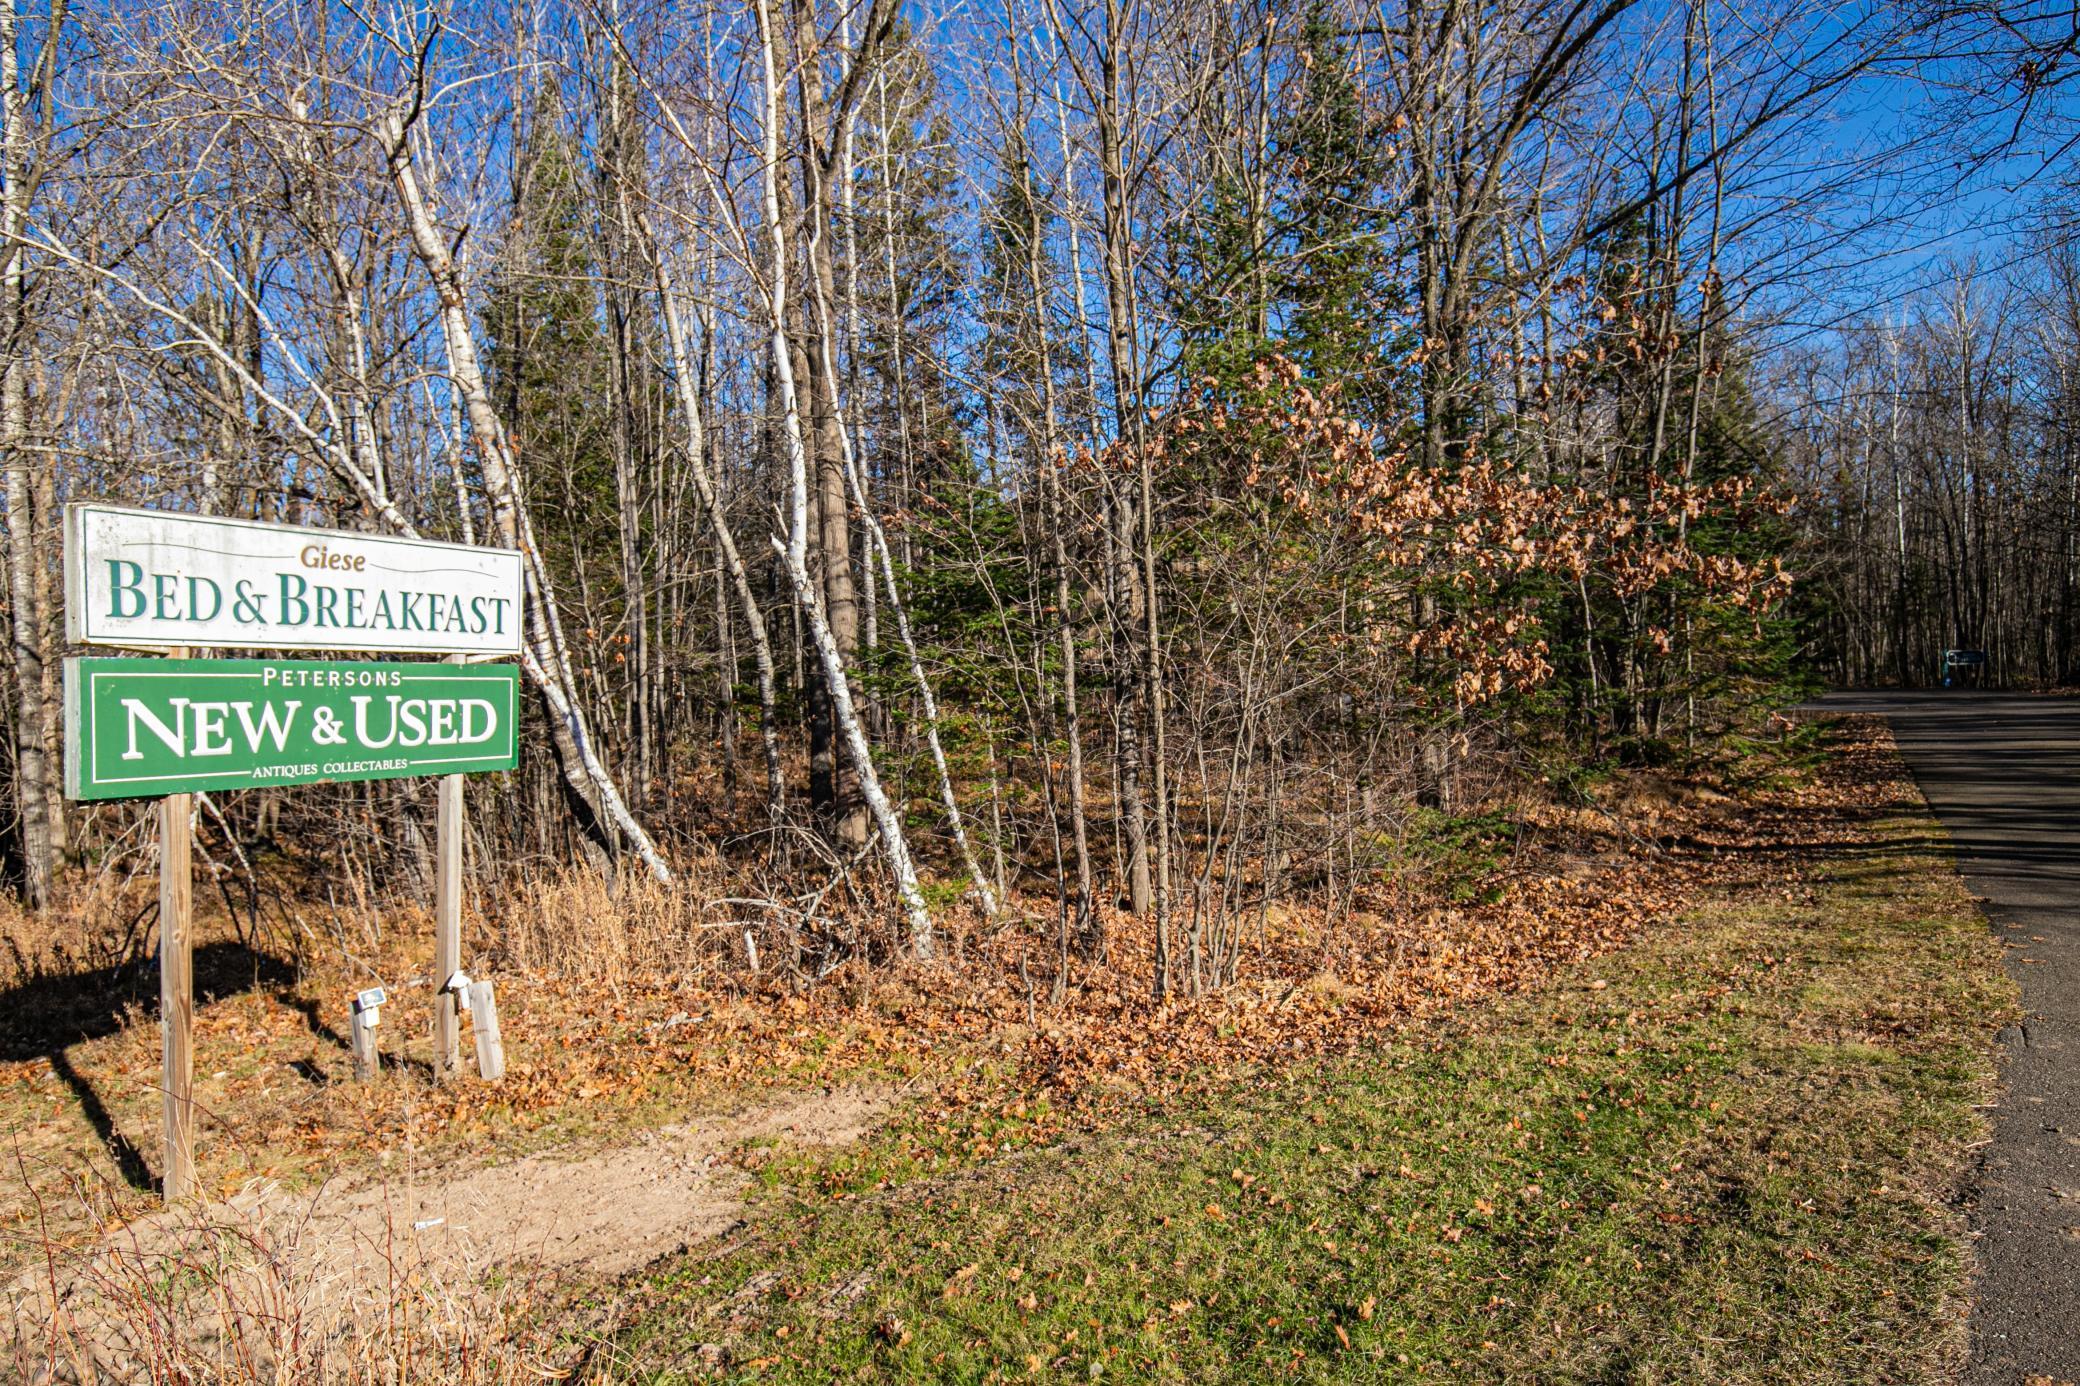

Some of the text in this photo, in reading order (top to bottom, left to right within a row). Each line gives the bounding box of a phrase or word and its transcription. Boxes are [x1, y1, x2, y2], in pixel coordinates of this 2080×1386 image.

[299, 544, 366, 573] Giese
[104, 559, 511, 635] BED & BREAKFAST
[263, 667, 401, 687] PETERSONS
[120, 695, 498, 761] NEW & USED
[252, 758, 408, 778] ANTIQUES COLLECTABLES
